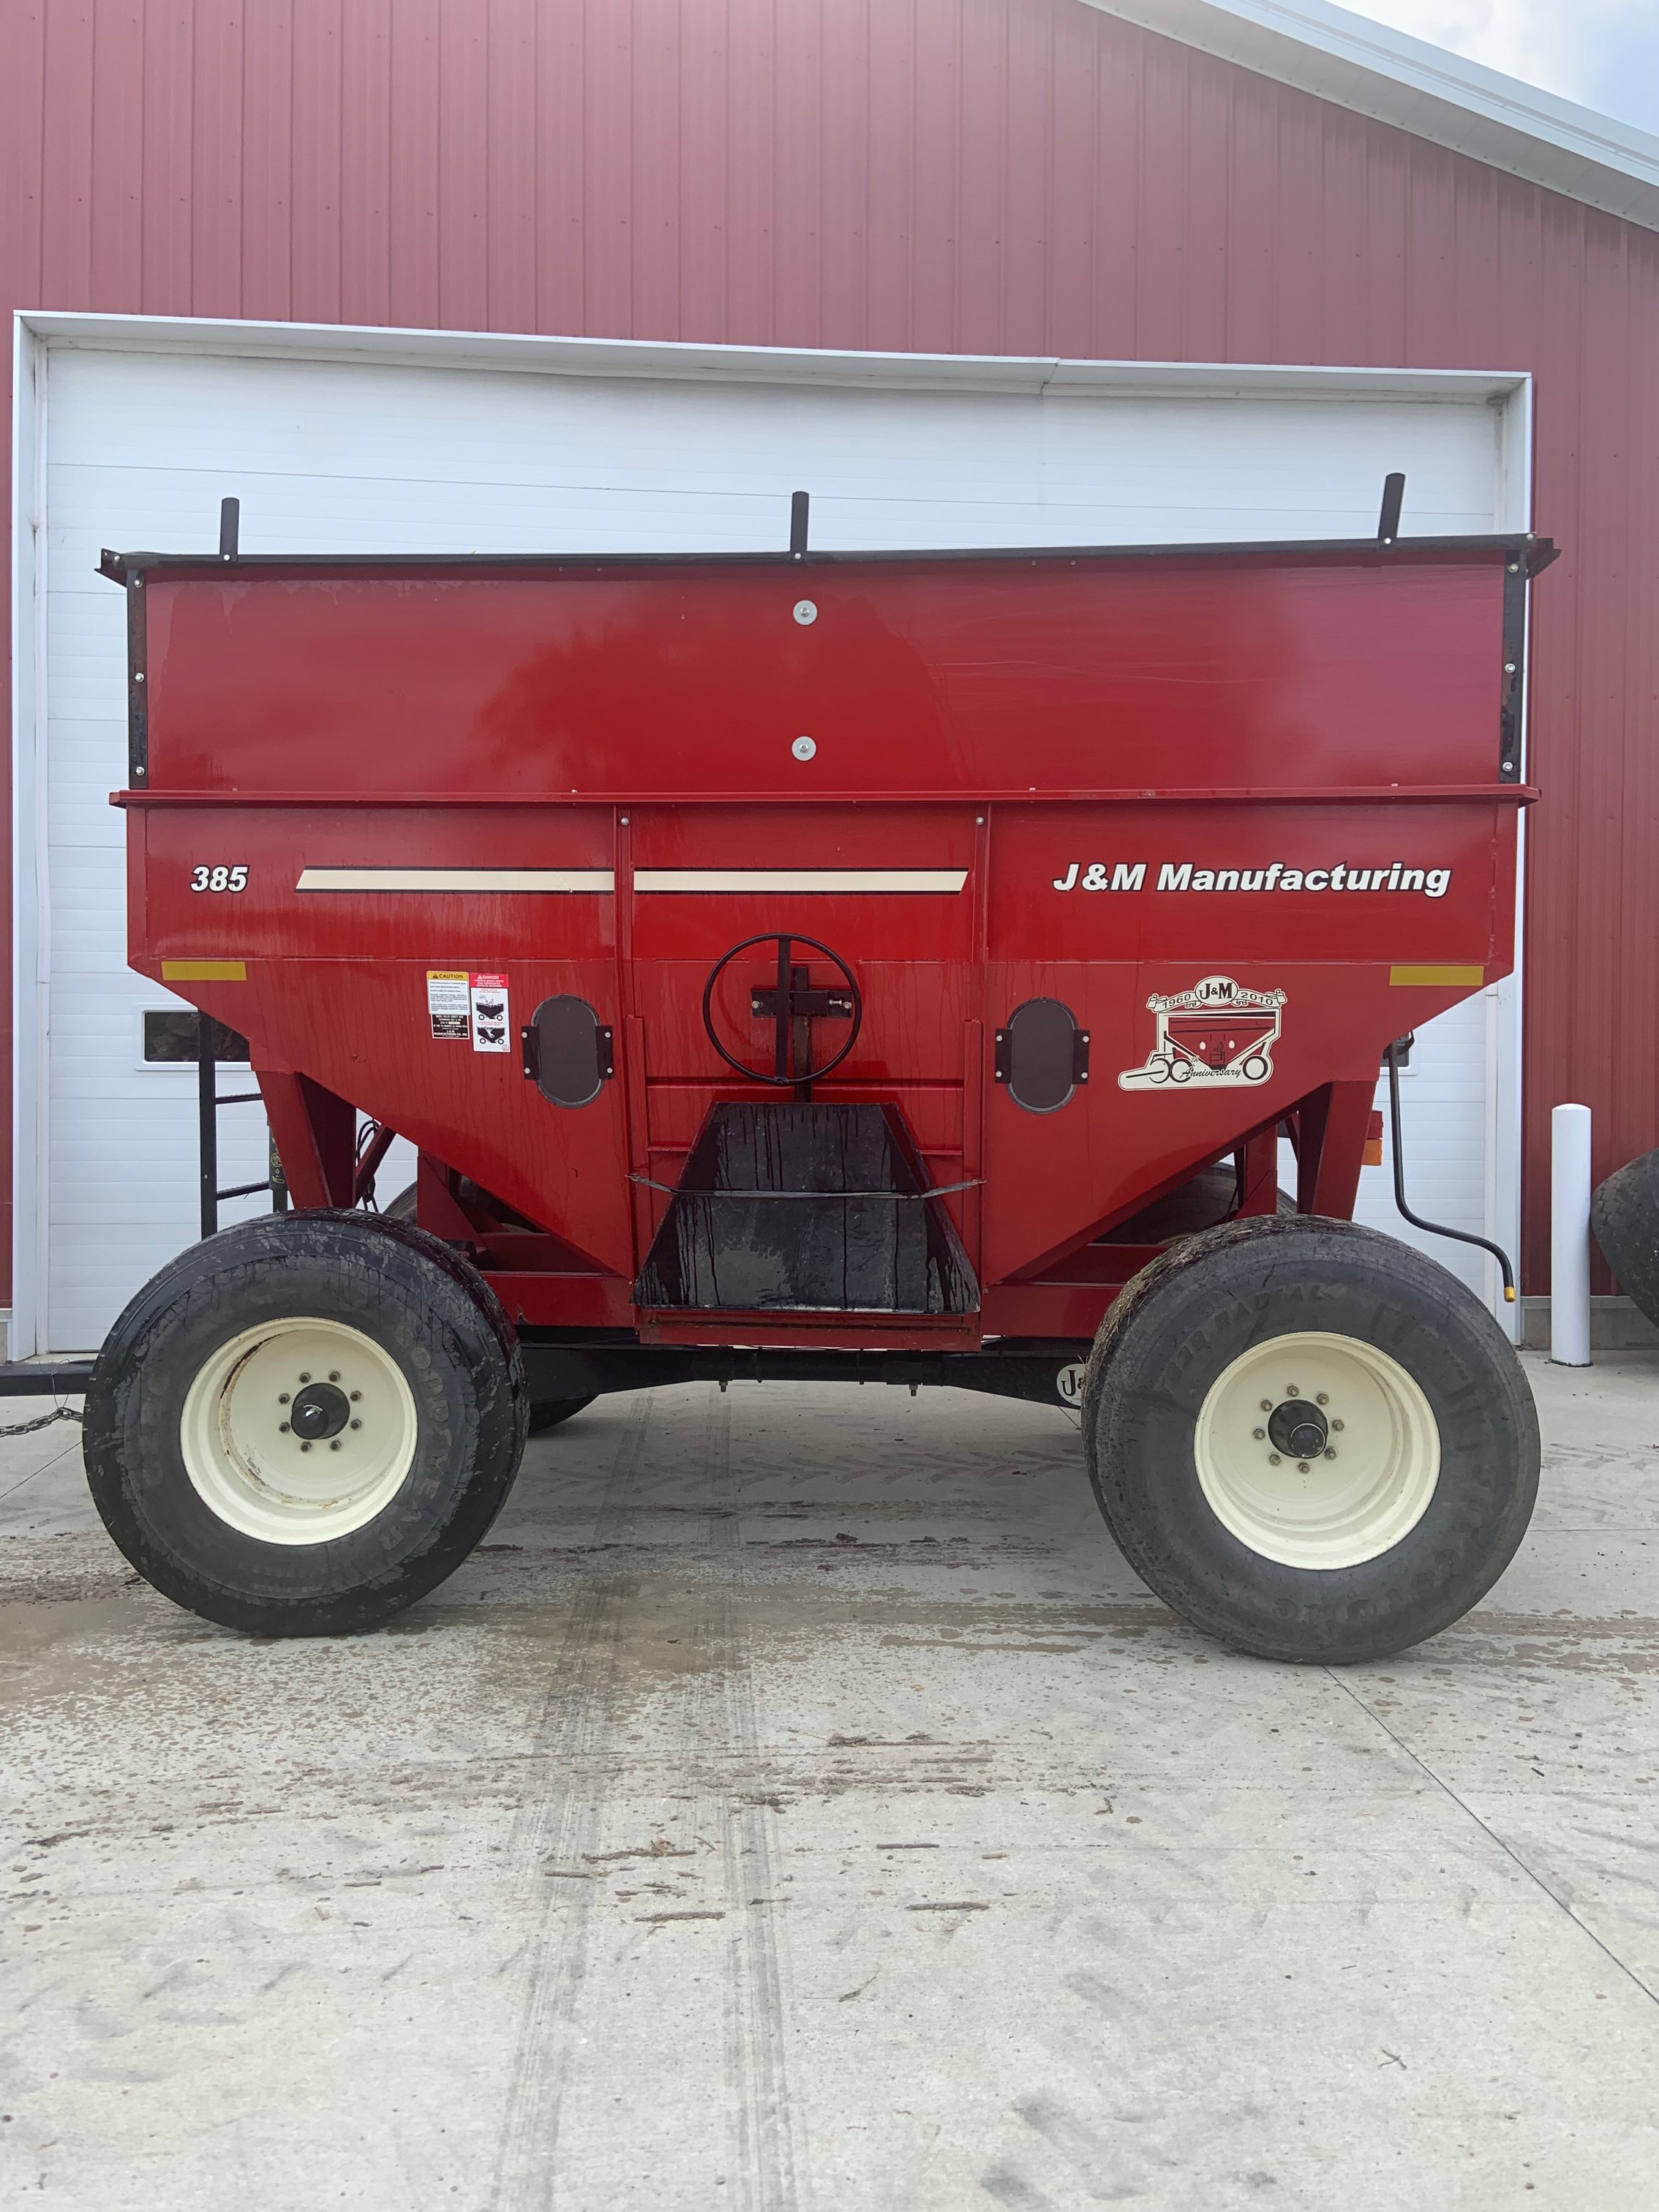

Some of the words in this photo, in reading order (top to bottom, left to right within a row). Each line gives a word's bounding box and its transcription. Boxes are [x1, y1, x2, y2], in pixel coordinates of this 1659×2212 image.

[189, 865, 249, 892] 385
[1053, 863, 1147, 892] J&M
[1156, 862, 1451, 898] Manufacturing
[1162, 993, 1191, 1009] 1960
[1199, 982, 1233, 1000] J&M
[1241, 992, 1274, 1006] 2010
[1179, 1066, 1241, 1078] Anniversary
[1061, 1370, 1084, 1396] J&
